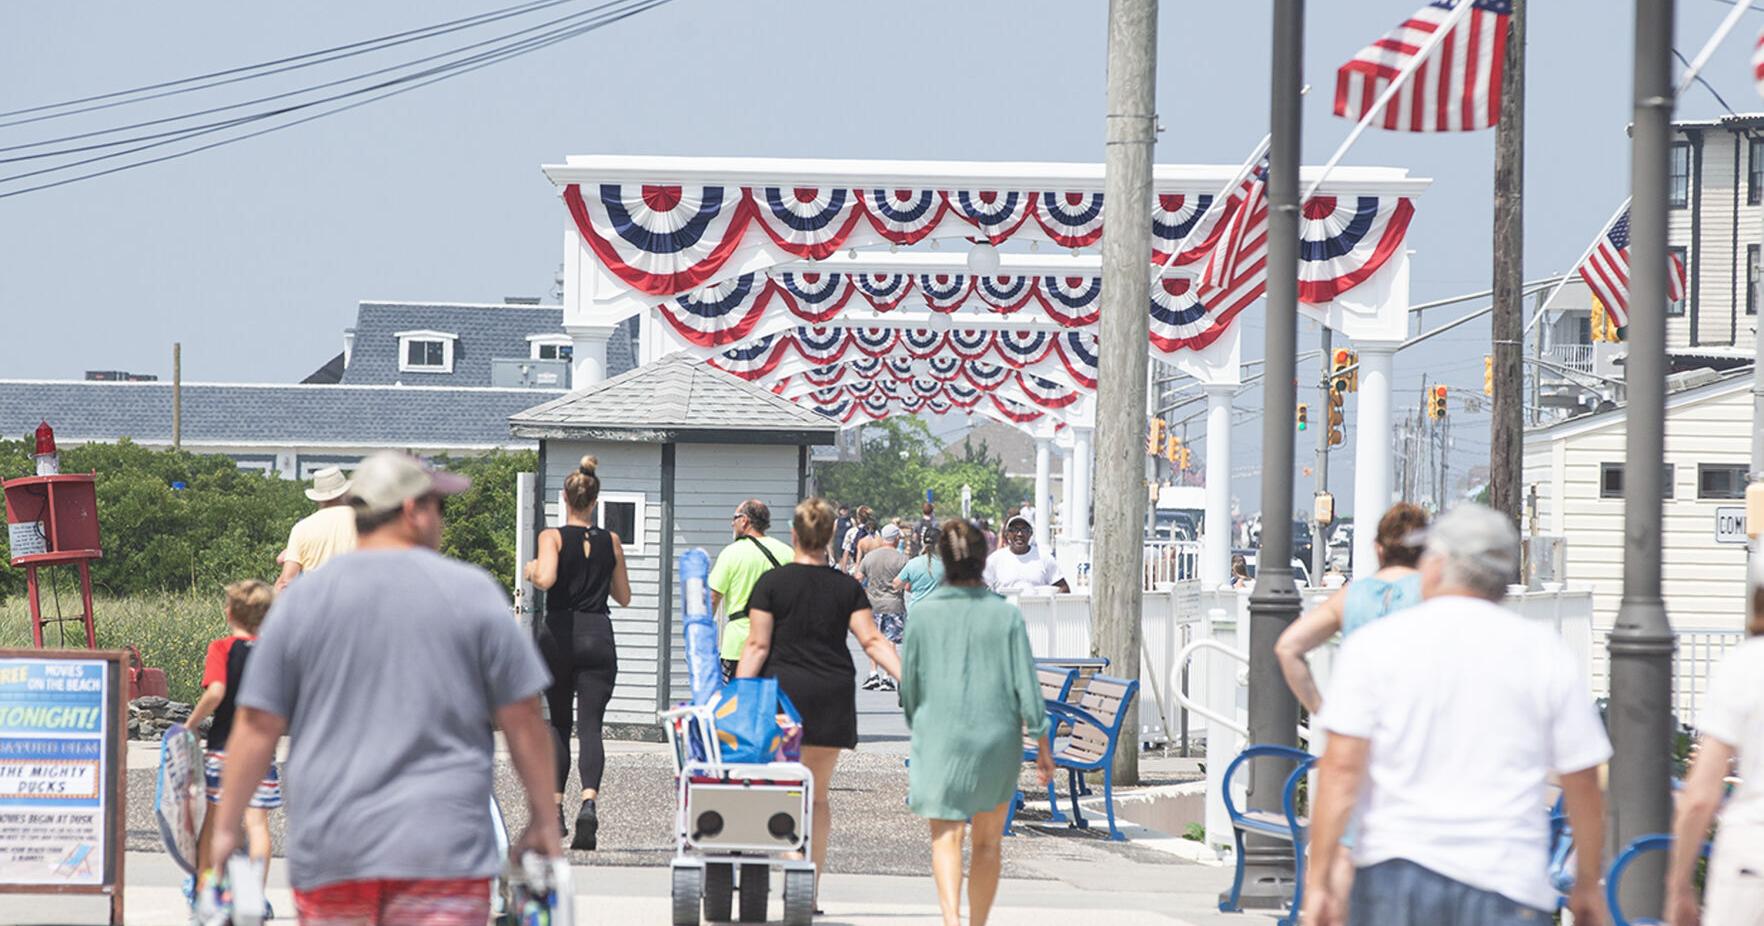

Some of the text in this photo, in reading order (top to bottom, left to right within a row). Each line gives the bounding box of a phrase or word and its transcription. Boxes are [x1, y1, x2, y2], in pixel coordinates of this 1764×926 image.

[1720, 516, 1746, 534] COM
[45, 665, 83, 677] MOVIES
[28, 679, 101, 692] ON THE BEACH
[0, 706, 99, 729] TONIGHT!
[1, 766, 86, 777] THE MIGHTY
[18, 781, 65, 793] DUCKS
